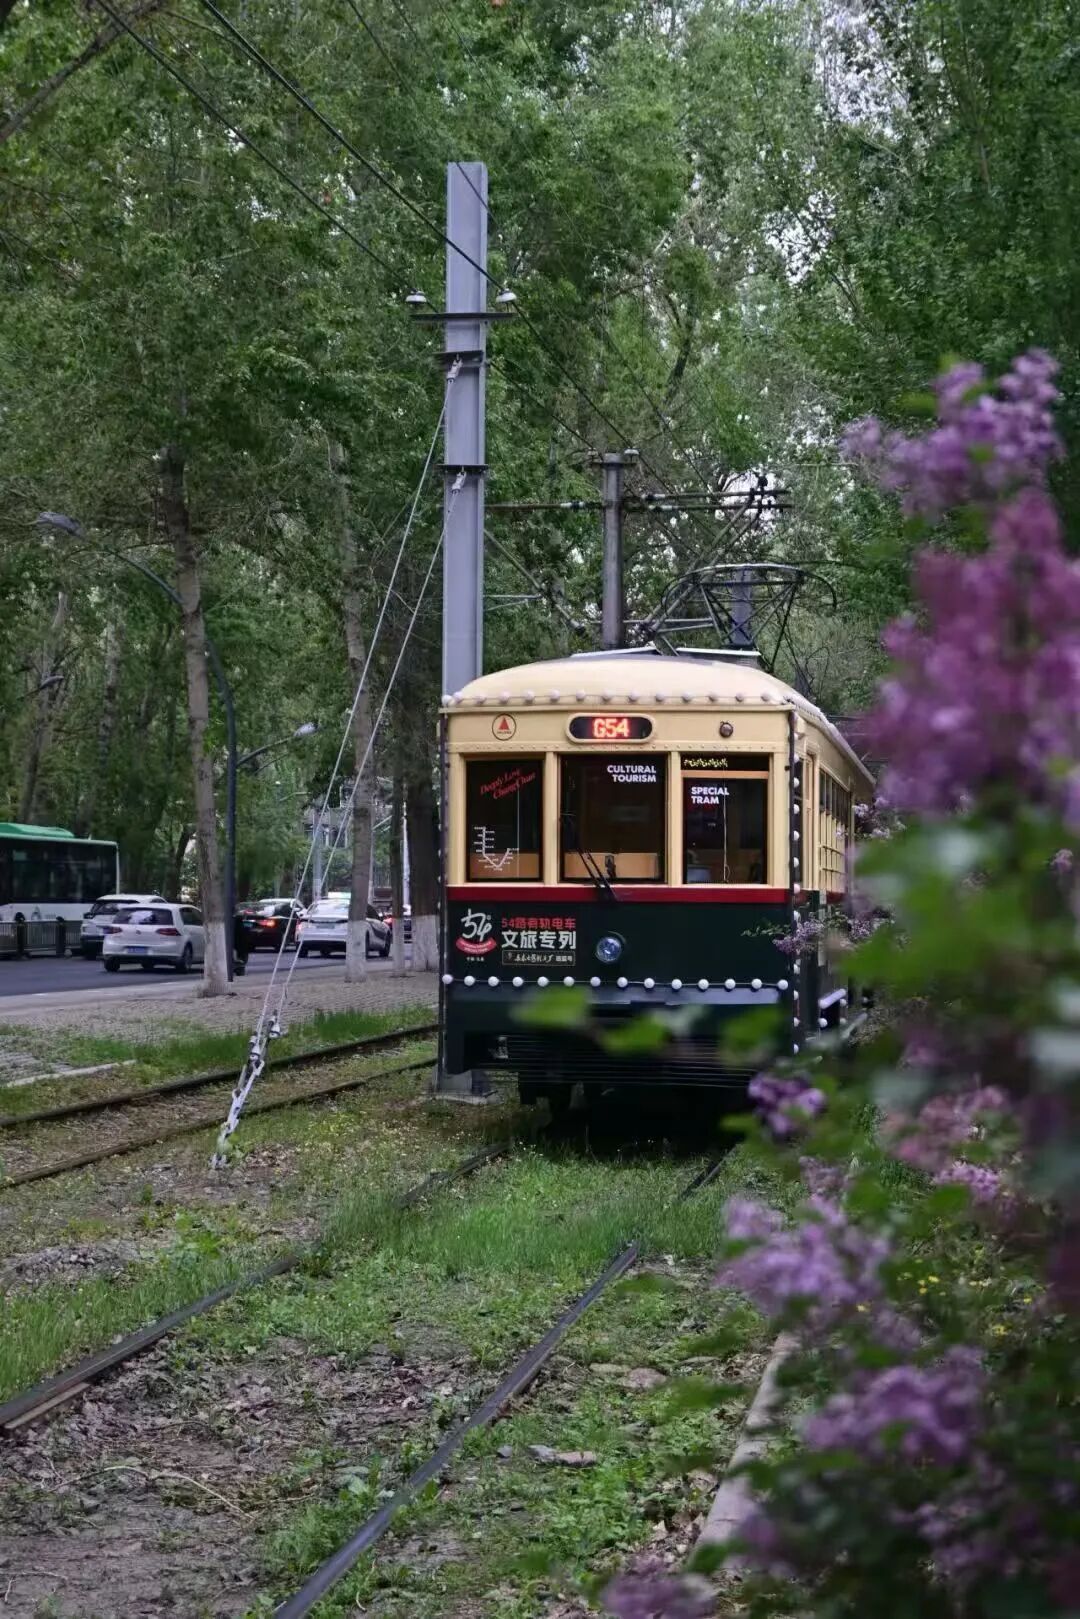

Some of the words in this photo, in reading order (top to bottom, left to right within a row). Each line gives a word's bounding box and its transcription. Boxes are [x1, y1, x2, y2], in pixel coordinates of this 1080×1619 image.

[593, 718, 630, 737] G54
[607, 765, 657, 774] CULTURAL
[613, 774, 657, 783] TOURISM
[691, 787, 729, 795] SPECIAL
[691, 796, 719, 804] TRAM
[501, 930, 576, 949] 文旅专列
